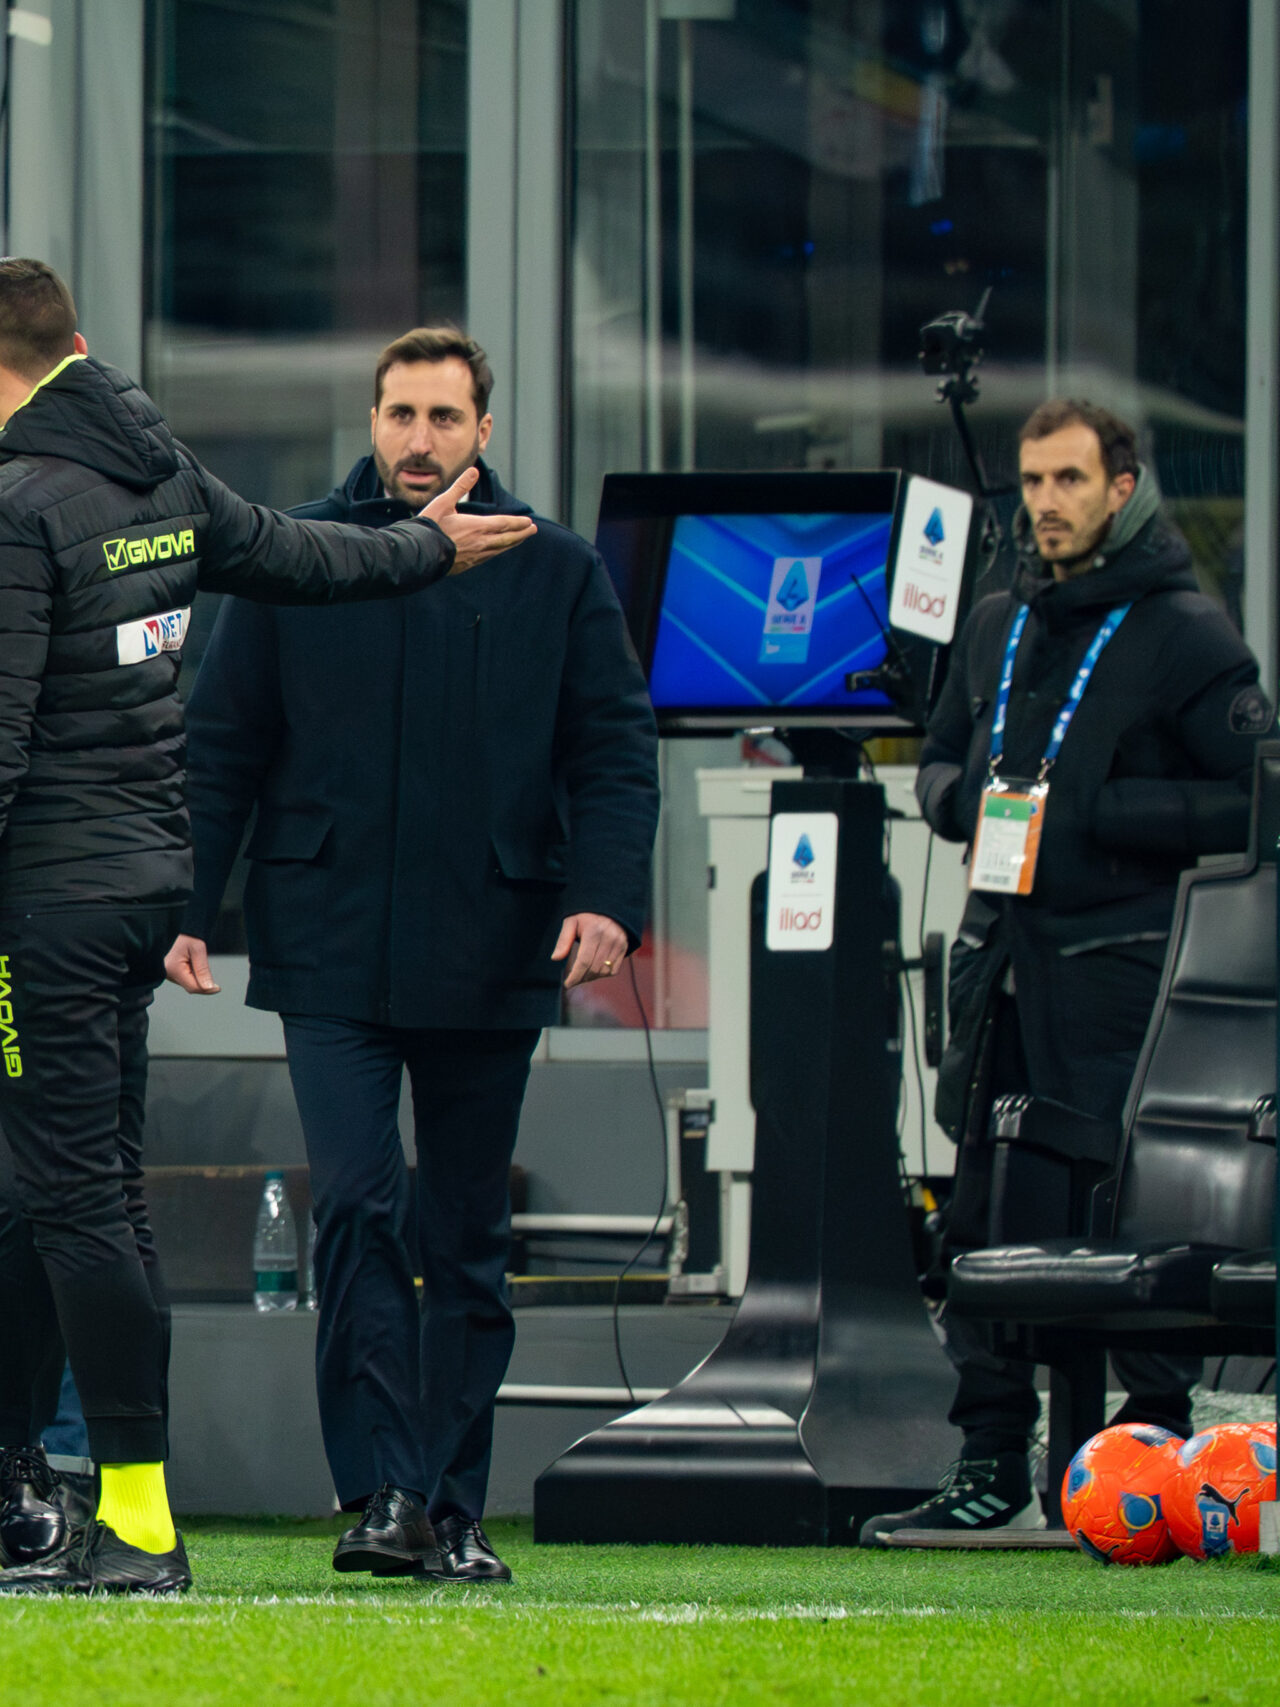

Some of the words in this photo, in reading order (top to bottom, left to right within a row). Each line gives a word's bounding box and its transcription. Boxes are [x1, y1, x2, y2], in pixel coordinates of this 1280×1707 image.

[127, 529, 195, 565] GIVOVA
[903, 582, 947, 619] iliad
[778, 907, 822, 931] iliad
